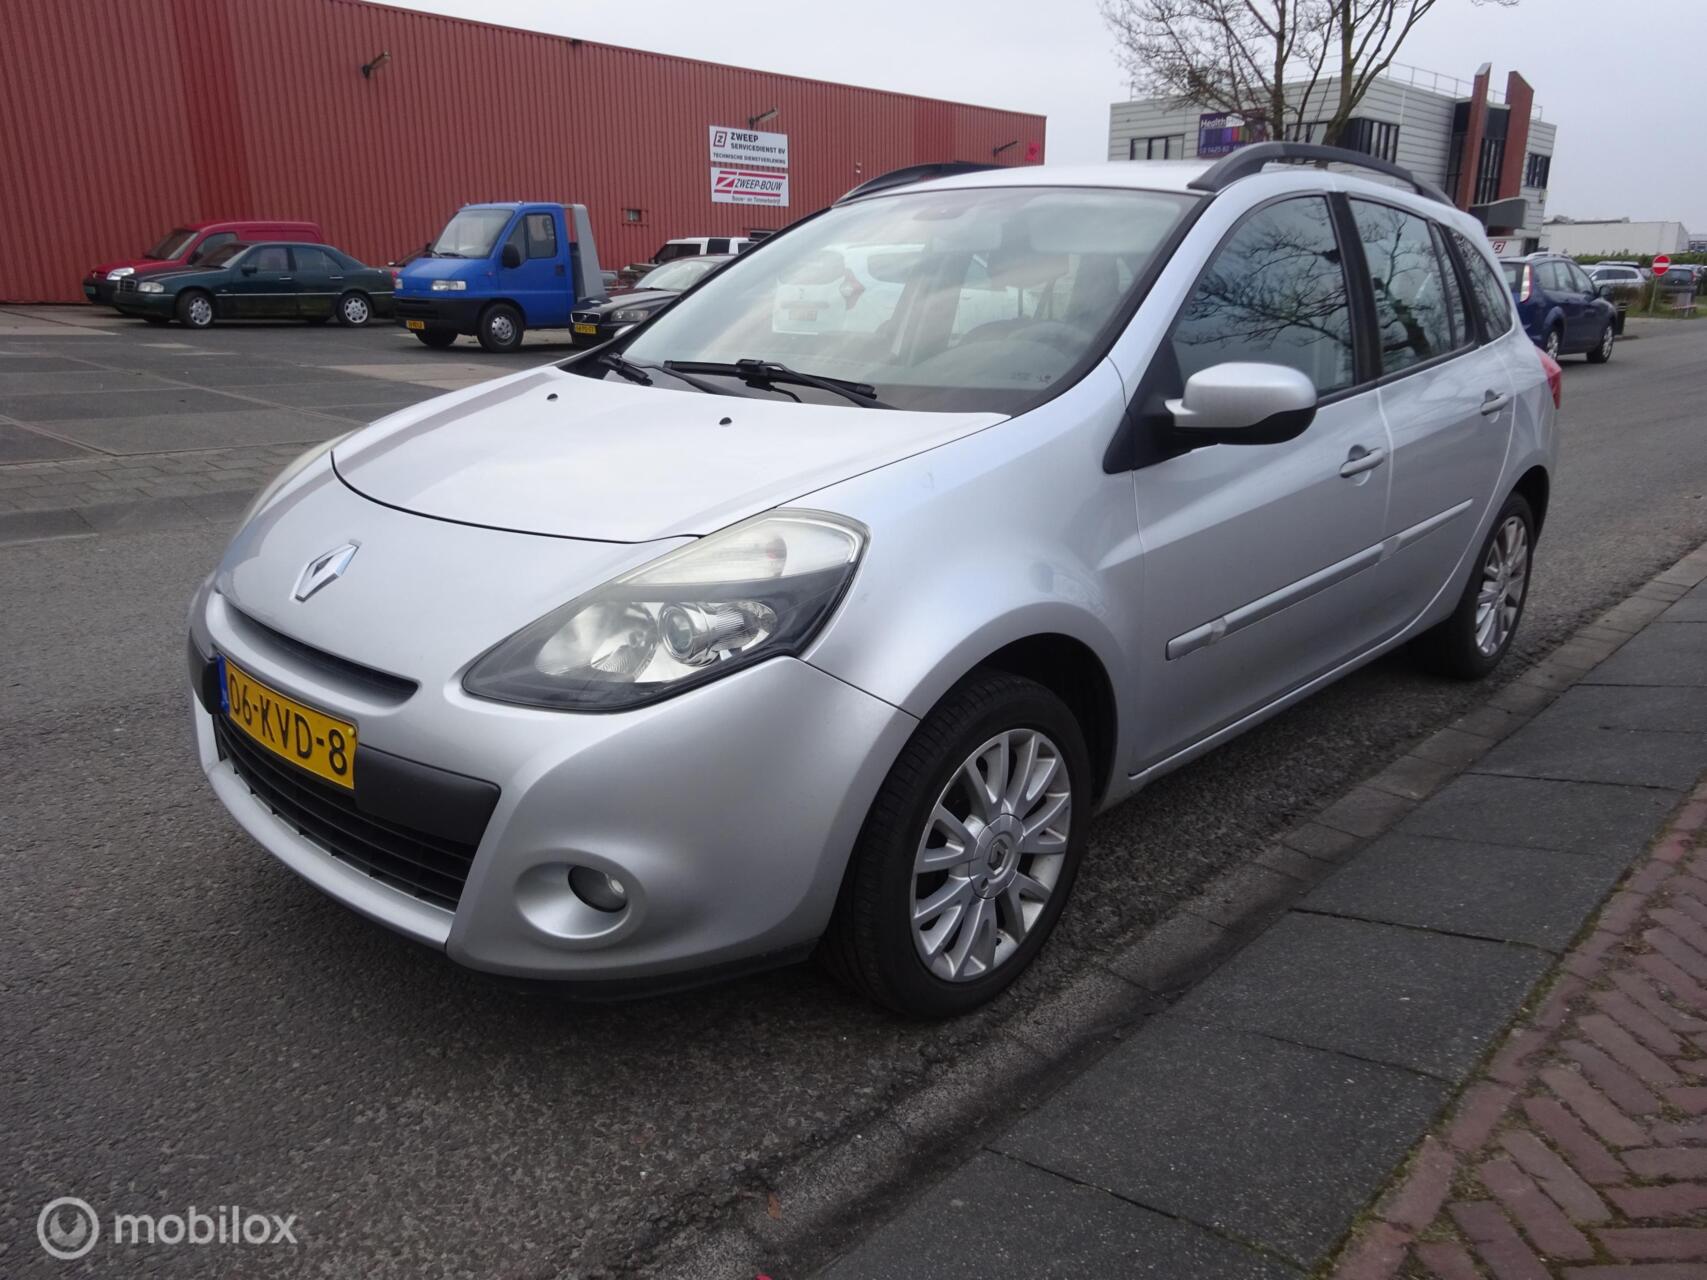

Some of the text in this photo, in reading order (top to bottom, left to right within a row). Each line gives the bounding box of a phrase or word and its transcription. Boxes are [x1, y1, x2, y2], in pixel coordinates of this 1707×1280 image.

[730, 132, 759, 142] ZWEEP
[731, 143, 777, 153] SERVICEDIENST
[713, 152, 743, 160] TECHNISCHE
[735, 179, 783, 191] ZWEEP-BOUW
[229, 672, 348, 776] 06-KVD-8
